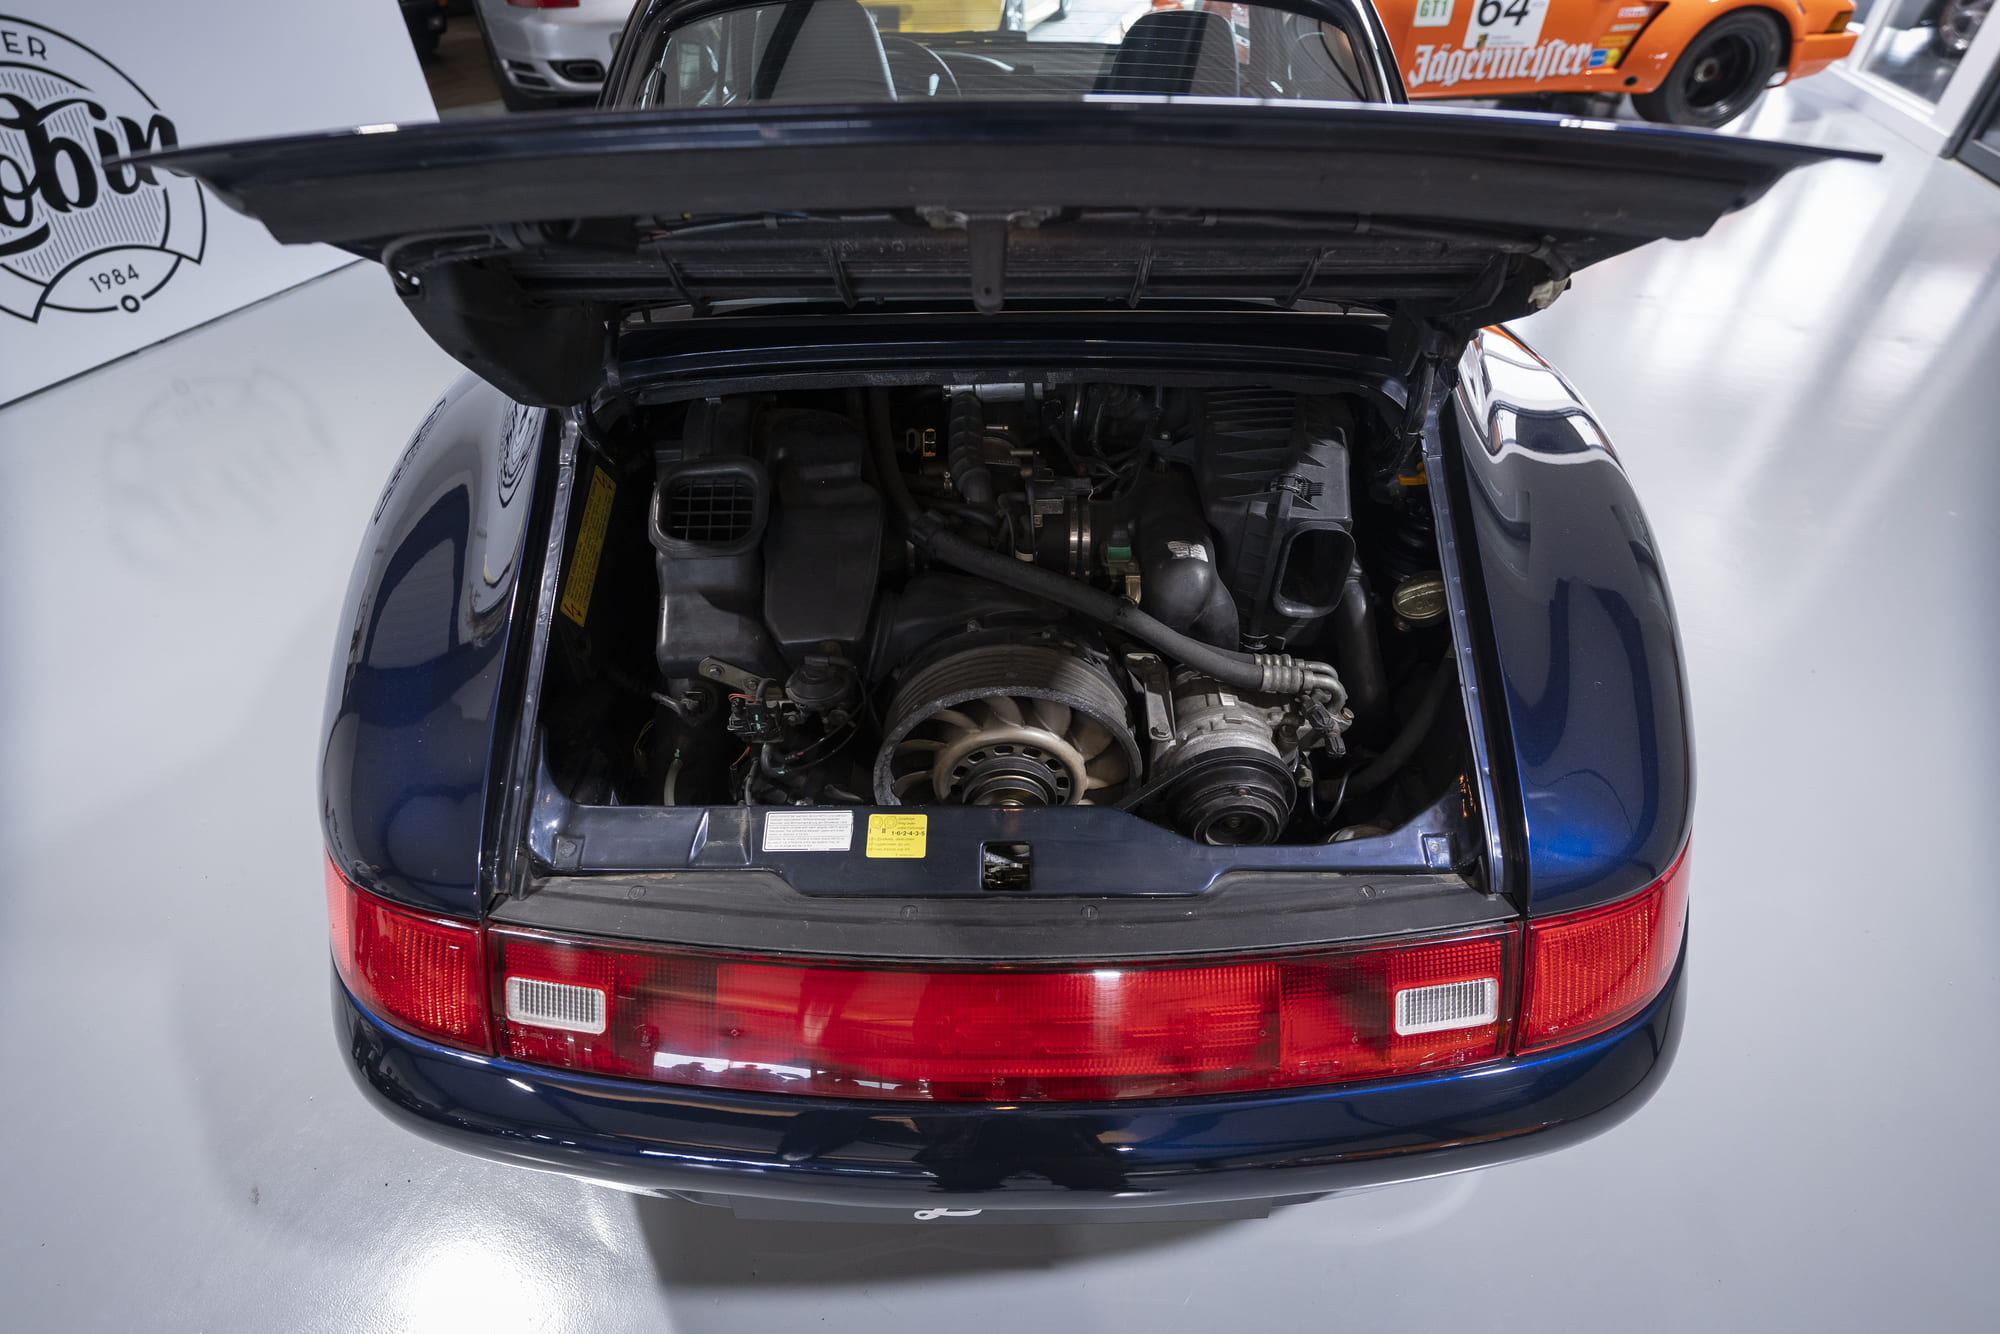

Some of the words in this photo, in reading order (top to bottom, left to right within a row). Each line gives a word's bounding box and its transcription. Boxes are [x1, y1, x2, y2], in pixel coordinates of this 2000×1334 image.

[1419, 0, 1448, 17] GT1
[1477, 0, 1530, 27] 64
[89, 264, 140, 293] 1984
